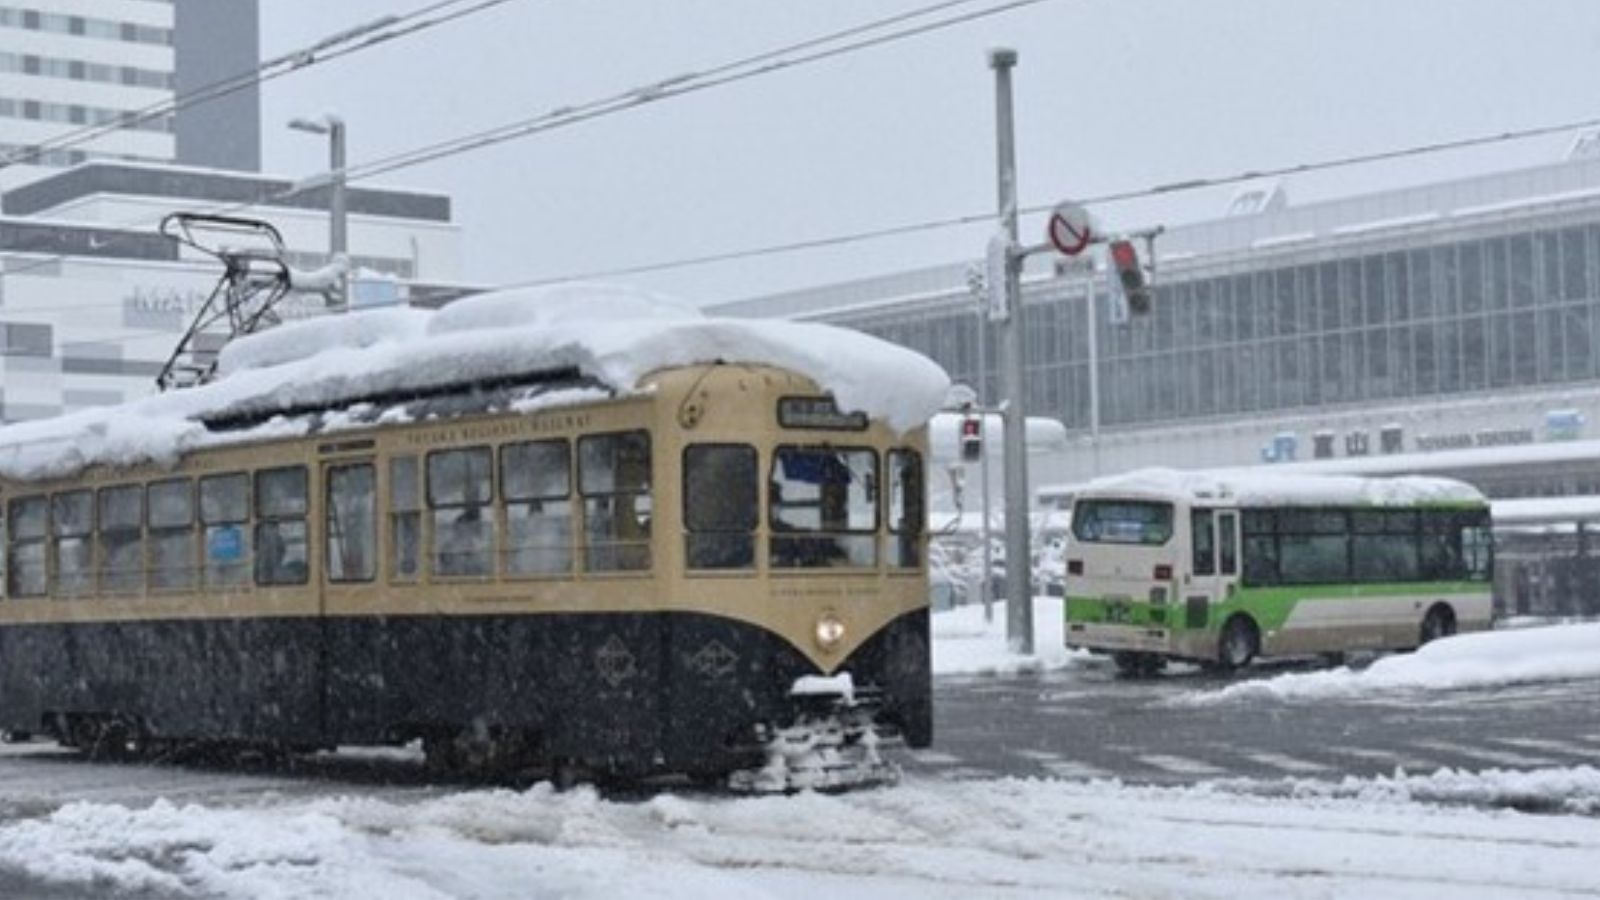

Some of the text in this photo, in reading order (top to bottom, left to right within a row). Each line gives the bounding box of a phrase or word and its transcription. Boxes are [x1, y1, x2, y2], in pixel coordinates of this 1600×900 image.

[1261, 435, 1297, 462] JR
[1313, 428, 1403, 459] 富山駅
[1475, 429, 1535, 447] STATION
